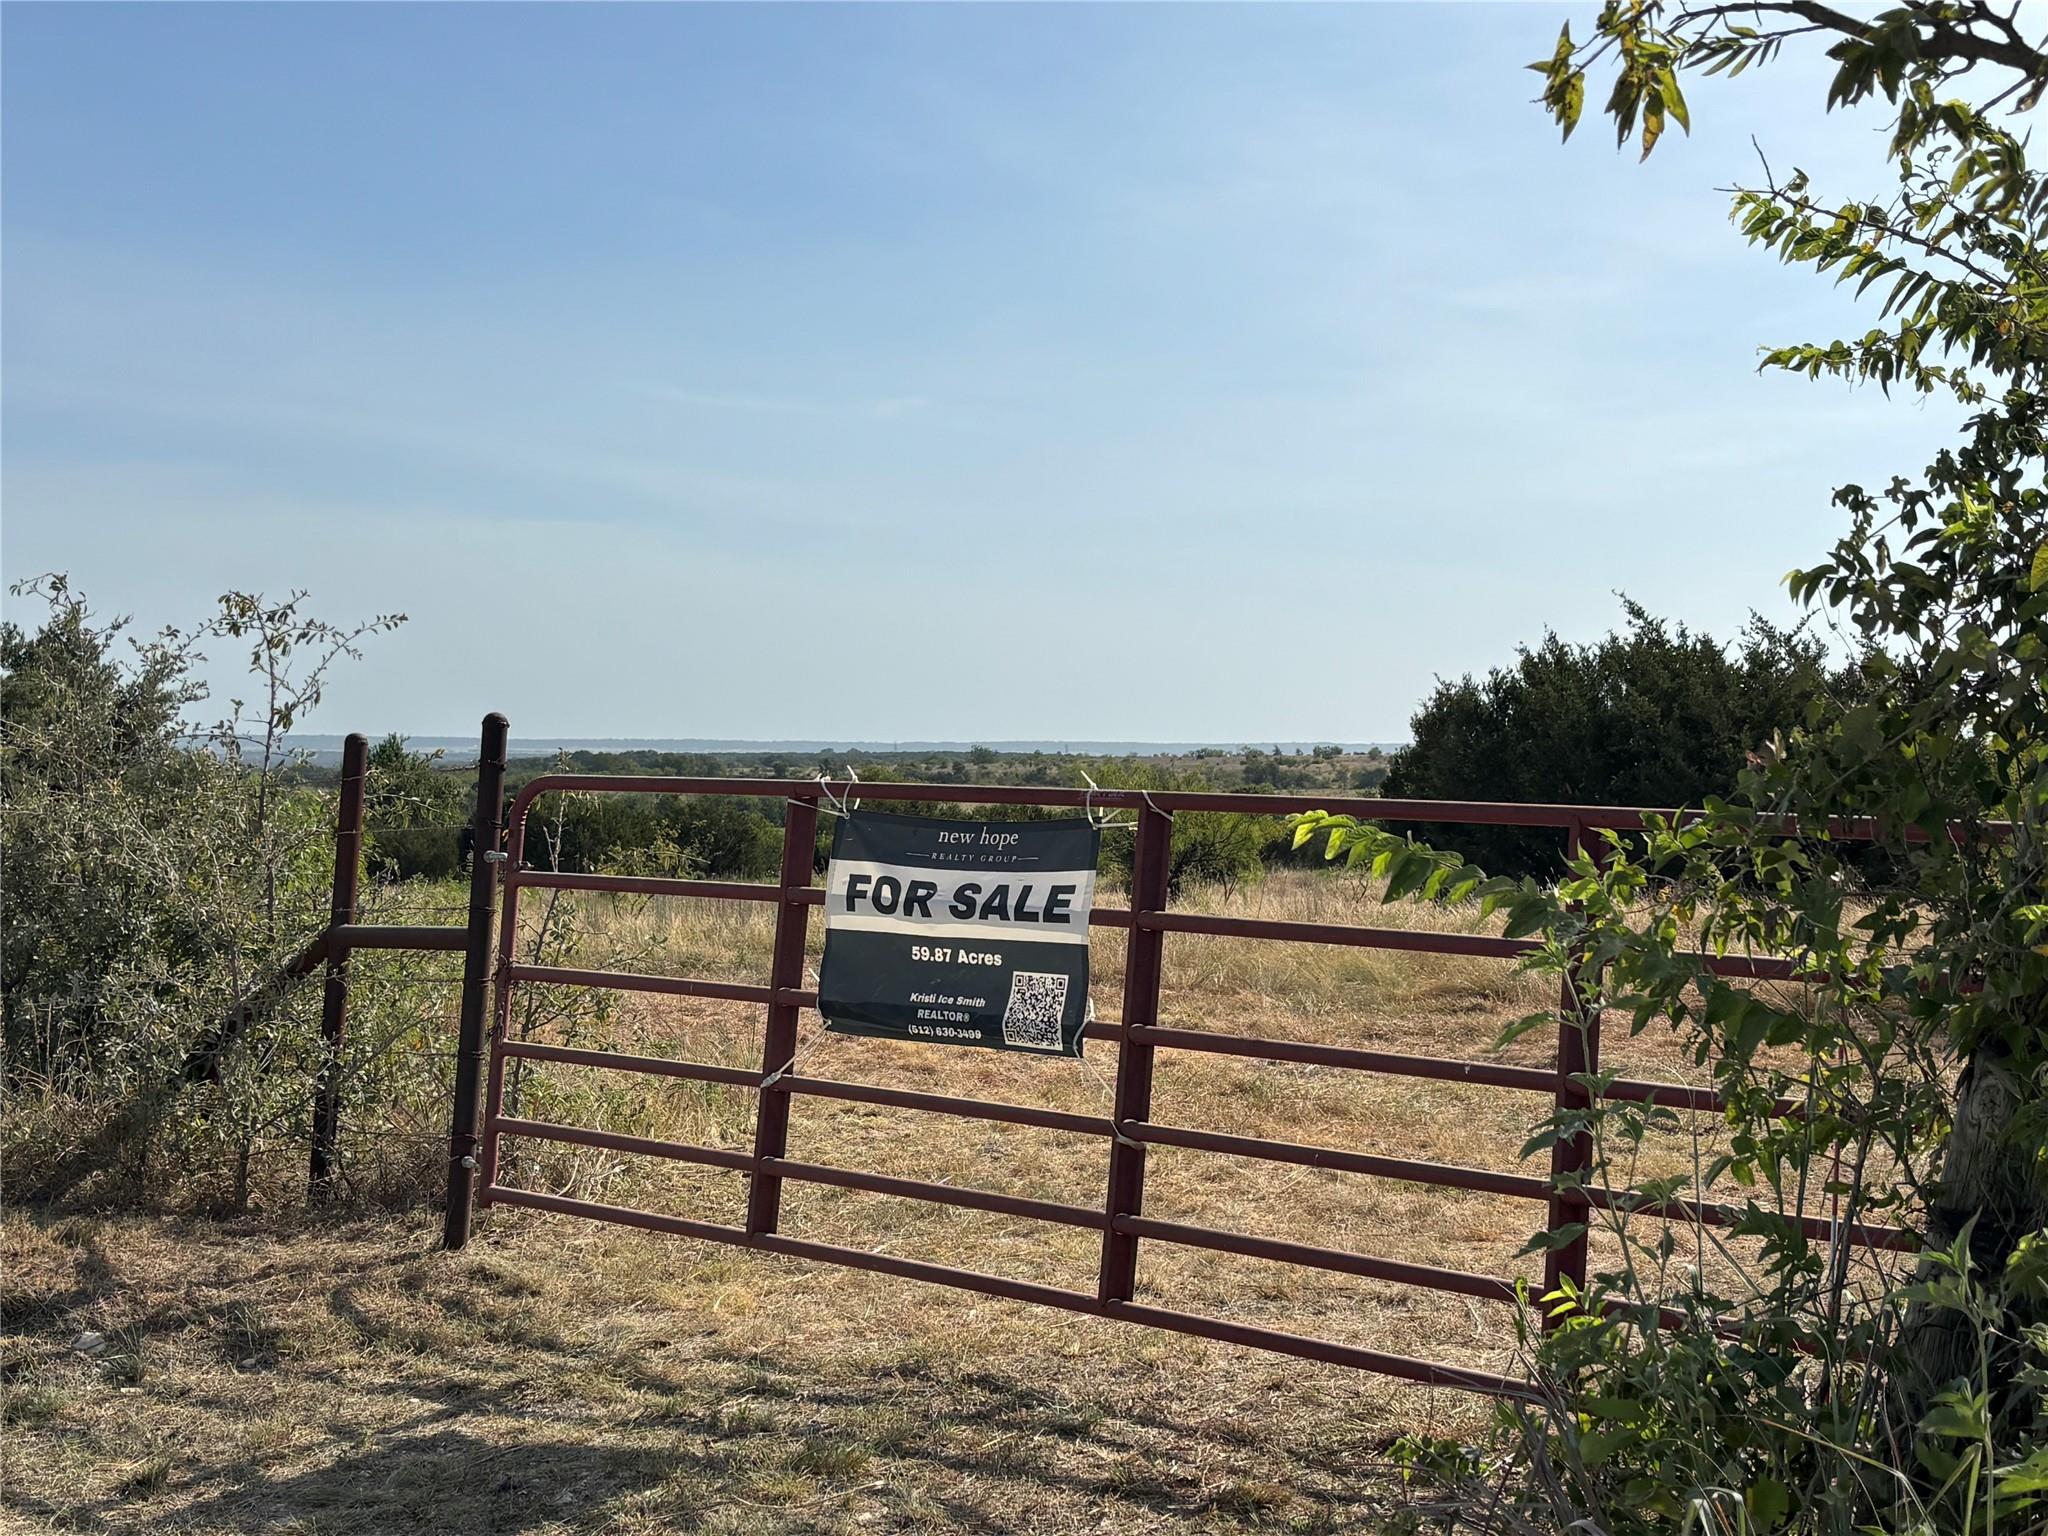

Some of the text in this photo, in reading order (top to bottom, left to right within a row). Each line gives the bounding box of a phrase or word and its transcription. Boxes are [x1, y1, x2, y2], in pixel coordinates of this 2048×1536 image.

[938, 826, 1019, 850] new hope
[932, 852, 1017, 863] REALTY GROUP
[846, 874, 1076, 924] FOR SALE
[911, 946, 1002, 966] 59.87 Acres
[909, 992, 986, 1008] Kristi Ice Smith
[908, 1024, 934, 1036] (512)
